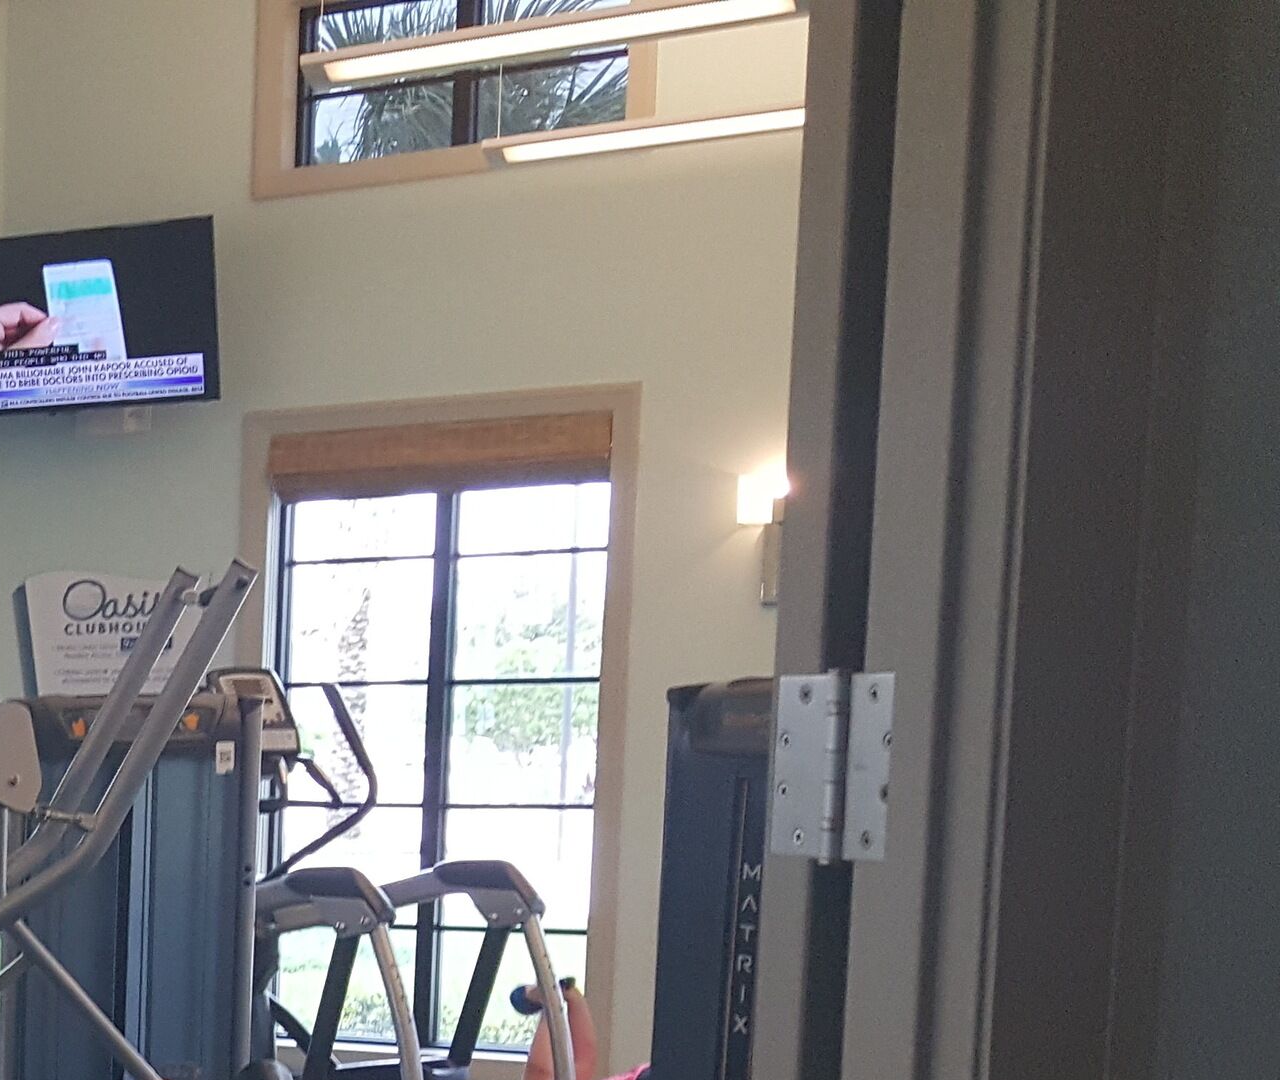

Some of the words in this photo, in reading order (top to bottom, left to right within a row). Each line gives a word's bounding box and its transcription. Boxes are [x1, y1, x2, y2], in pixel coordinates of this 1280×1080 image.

[0, 359, 10, 368] TO
[14, 357, 45, 367] PEOPLE
[15, 366, 65, 379] BILLIONAIRE
[68, 364, 92, 374] JOHN
[94, 361, 132, 372] KAPOOR
[134, 357, 174, 368] ACCUSED
[177, 356, 188, 366] OF
[5, 379, 17, 389] TO
[19, 377, 40, 388] BRIBE
[42, 374, 83, 386] DOCTORS
[85, 372, 107, 382] INTO
[108, 367, 165, 381] PRESCRIBING
[166, 365, 199, 376] OPIOID
[96, 382, 121, 392] NOW
[62, 579, 161, 621] Oasi
[64, 622, 147, 636] CLUBHOU
[733, 862, 763, 1035] MATRIX
